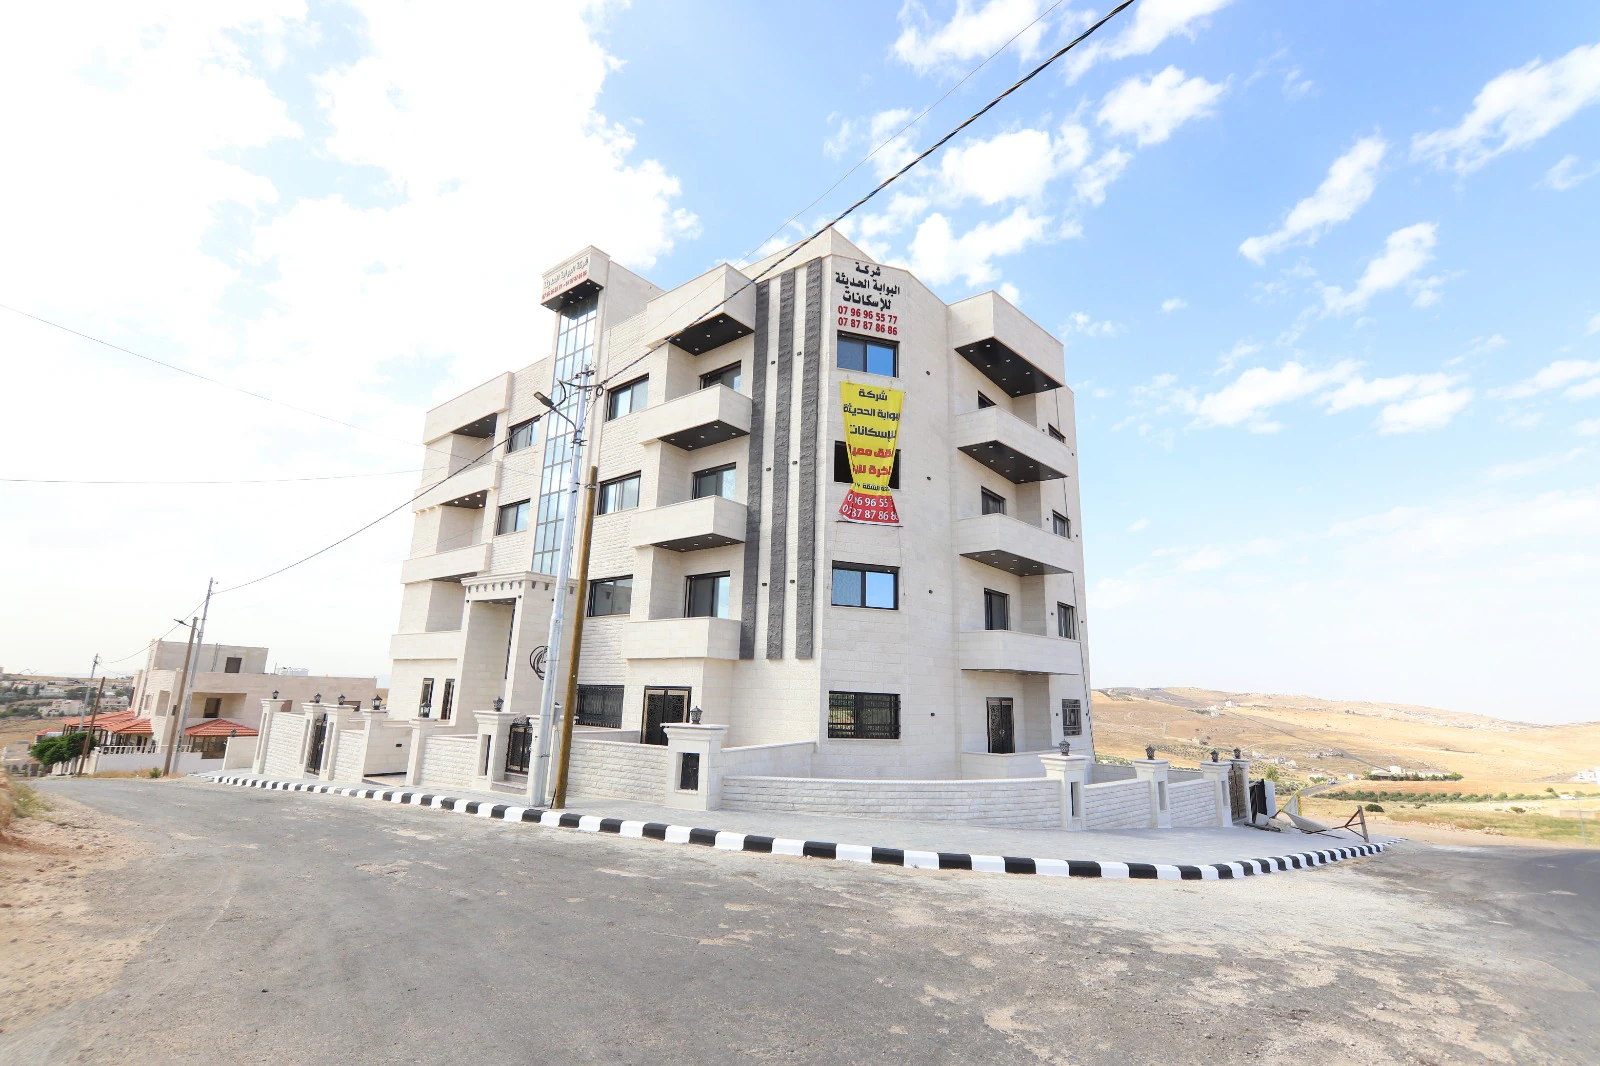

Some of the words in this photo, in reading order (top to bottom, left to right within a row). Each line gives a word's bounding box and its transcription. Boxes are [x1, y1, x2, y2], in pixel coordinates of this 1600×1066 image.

[855, 262, 880, 277] شركة
[836, 272, 870, 289] الحديثة
[872, 279, 900, 297] البوابة
[842, 290, 892, 312] للإسكانات
[838, 306, 848, 314] 07
[850, 308, 861, 318] 96
[864, 310, 873, 320] 96
[876, 312, 886, 322] 55
[888, 314, 898, 324] 77
[838, 317, 848, 326] 07
[850, 318, 861, 328] 87
[863, 320, 873, 330] 87
[876, 323, 886, 333] 86
[888, 326, 898, 336] 86
[858, 389, 888, 402] شركة
[844, 402, 876, 416] الحديثة
[865, 498, 876, 506] 96
[879, 498, 888, 508] 55
[864, 510, 876, 519] 87
[878, 510, 888, 520] 86
